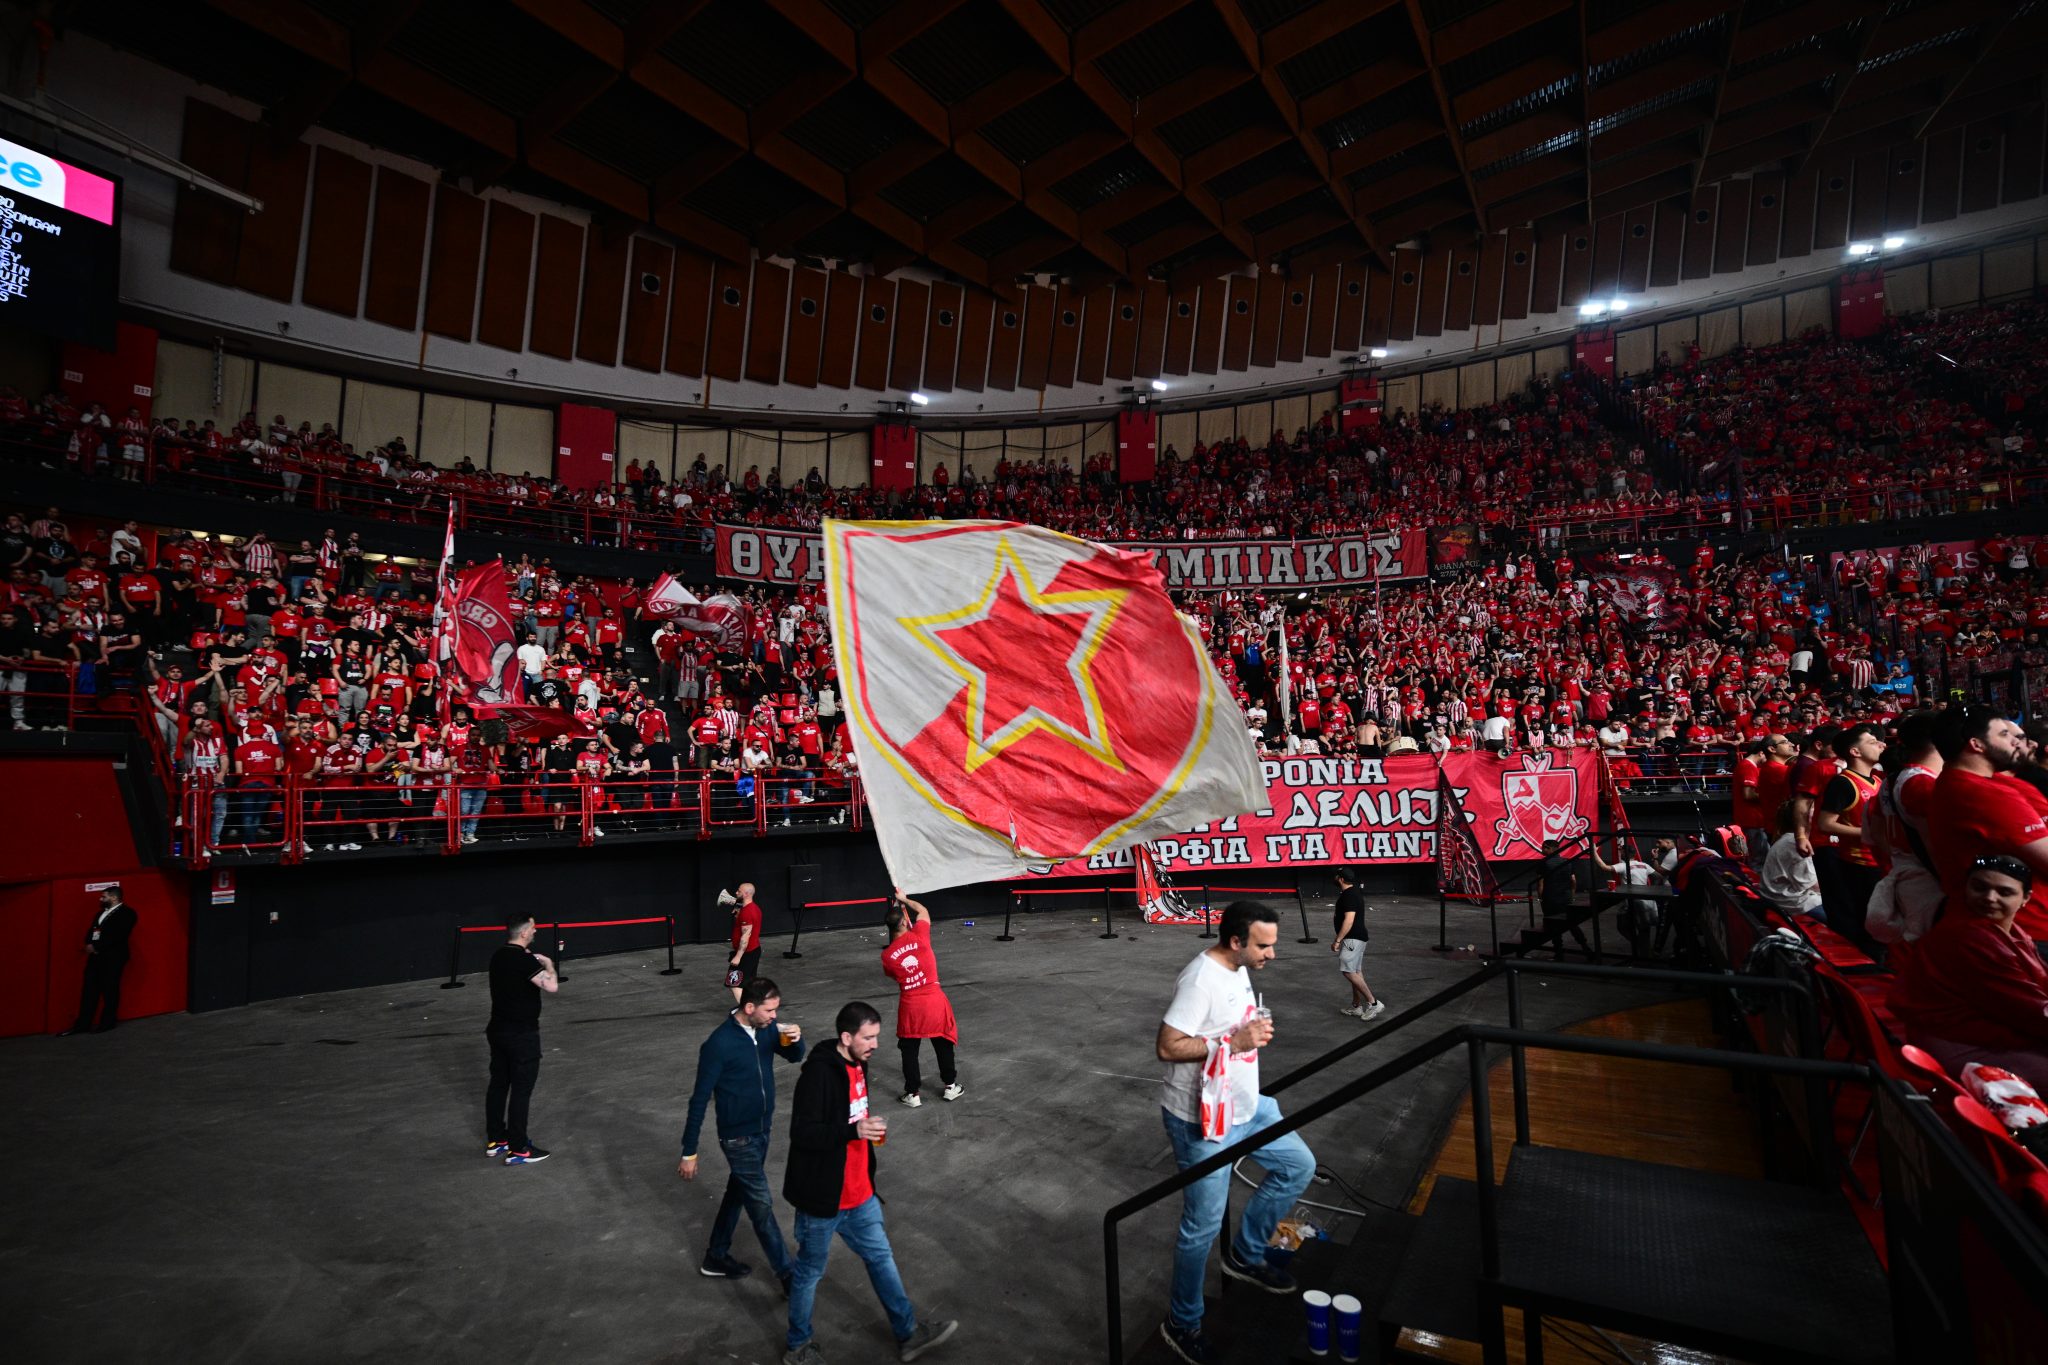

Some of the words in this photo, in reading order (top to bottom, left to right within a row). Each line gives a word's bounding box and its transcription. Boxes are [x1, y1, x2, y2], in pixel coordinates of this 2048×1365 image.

[1265, 833, 1330, 861] ΓΙΑ
[890, 942, 918, 960] TRIKALA
[906, 971, 924, 983] CLUB
